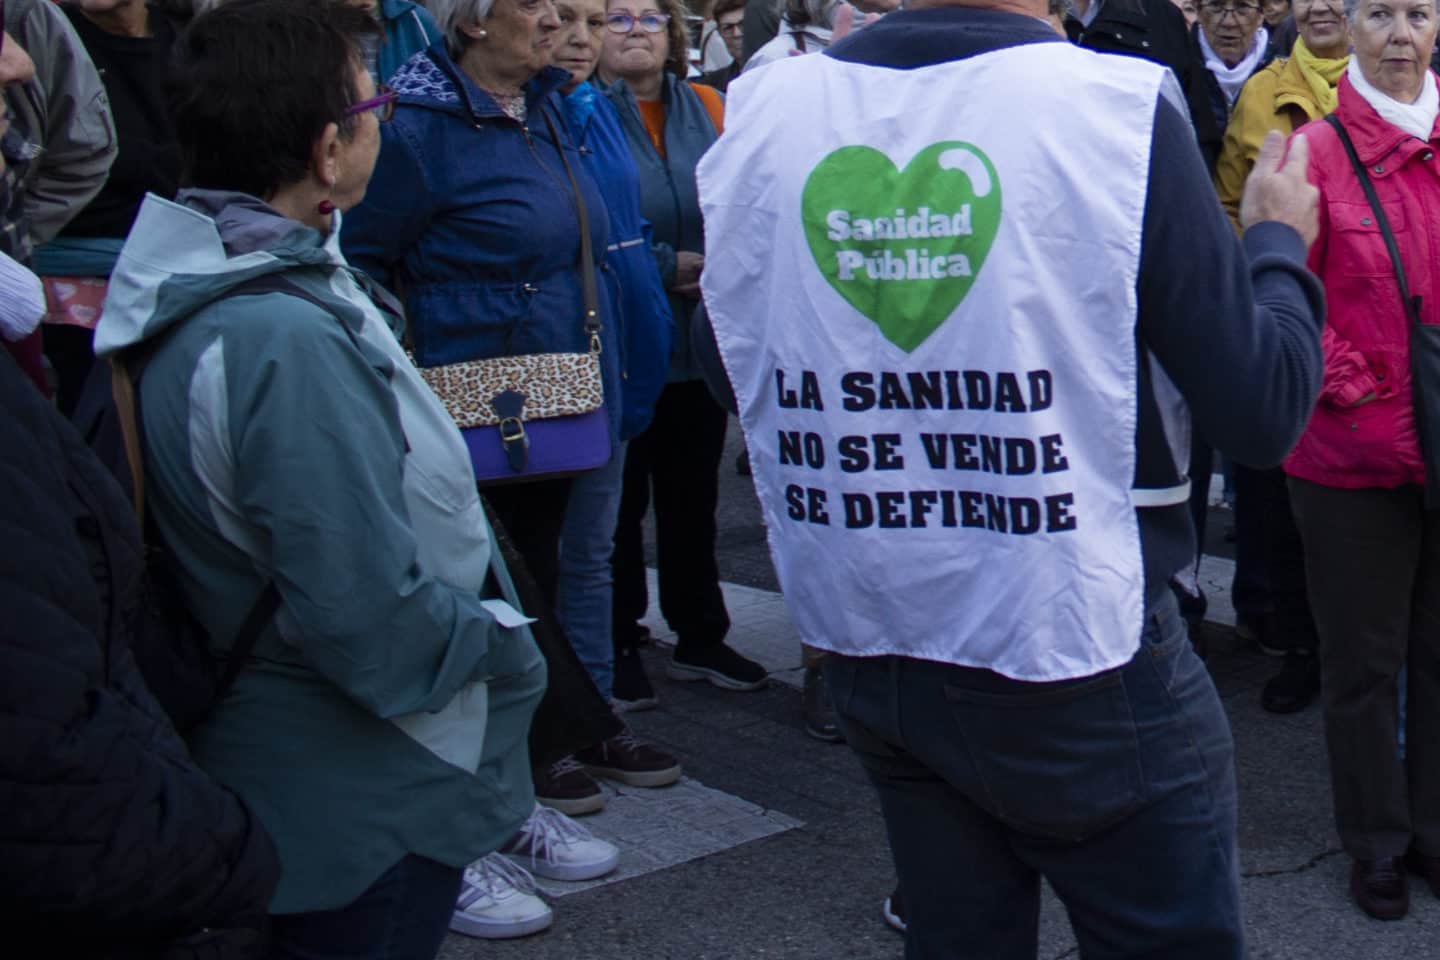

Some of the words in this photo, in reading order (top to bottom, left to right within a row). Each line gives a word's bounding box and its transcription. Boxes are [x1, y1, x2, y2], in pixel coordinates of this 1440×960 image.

[826, 204, 973, 242] Sanidad
[837, 249, 972, 281] Pública
[775, 369, 824, 412] LA
[841, 369, 1053, 413] SANIDAD
[778, 430, 825, 470] NO
[839, 433, 905, 473] SE
[920, 432, 1070, 476] VENDE
[786, 484, 829, 526] SE
[843, 490, 1077, 535] DEFIENDE
